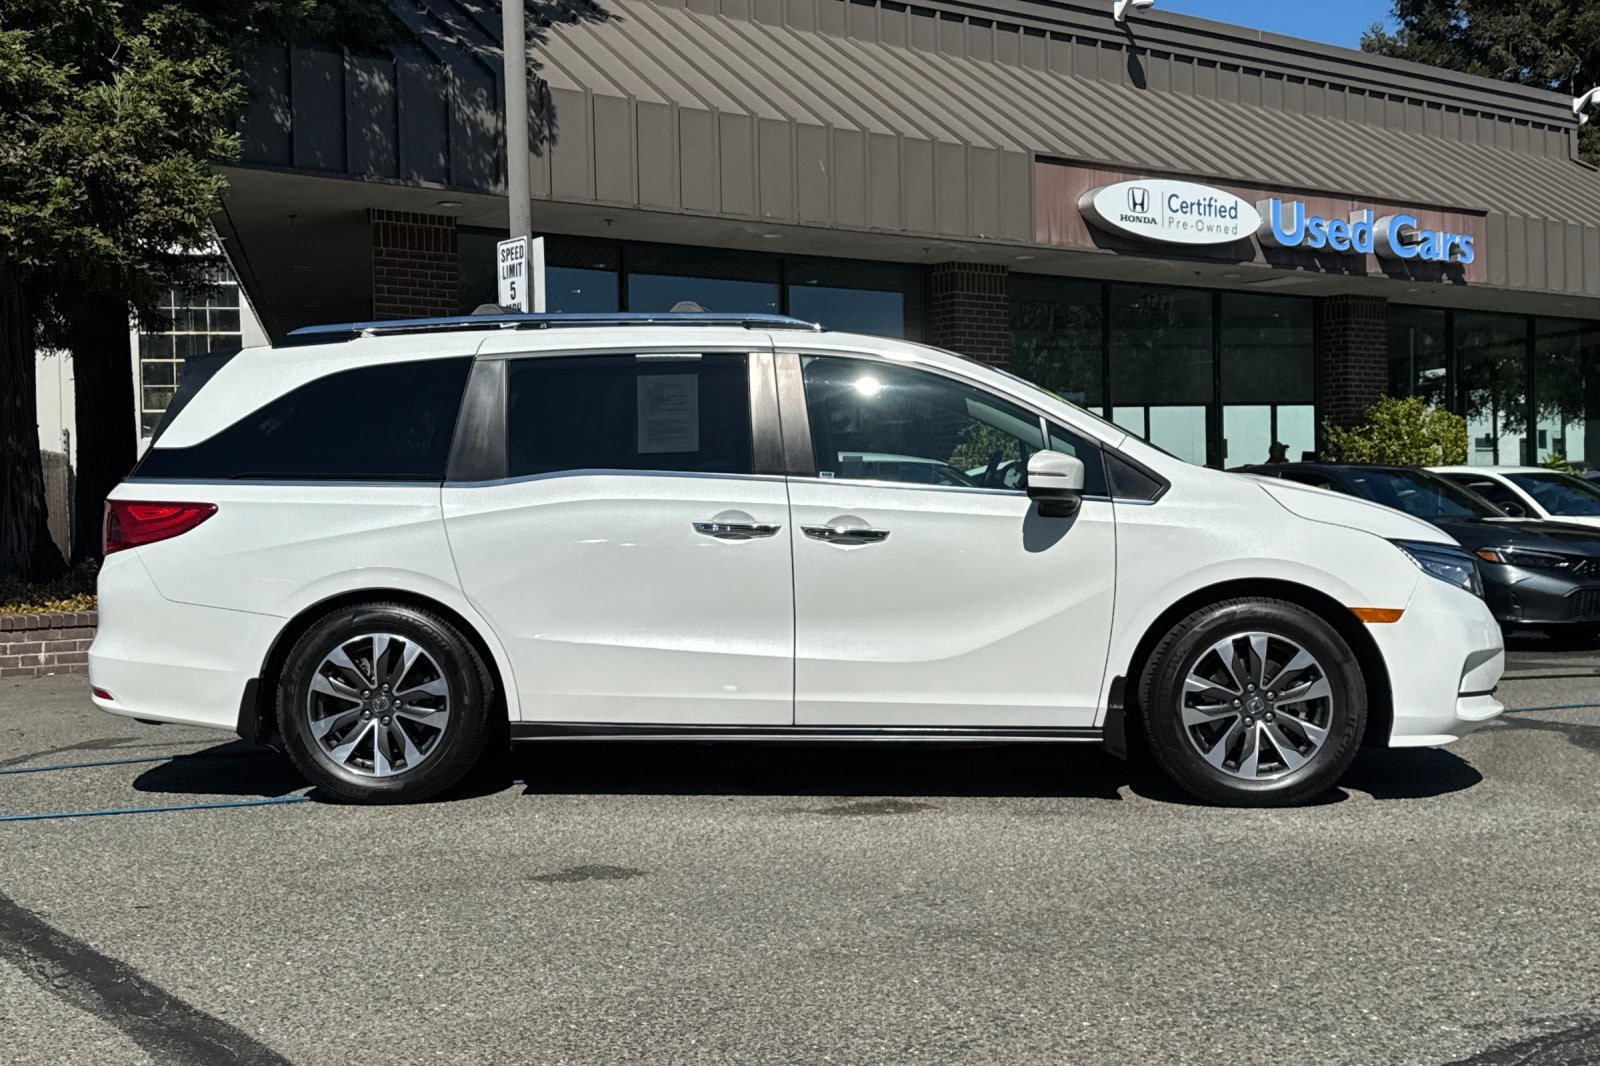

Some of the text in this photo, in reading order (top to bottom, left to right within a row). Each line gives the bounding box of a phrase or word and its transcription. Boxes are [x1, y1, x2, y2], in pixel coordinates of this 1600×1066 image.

[1167, 193, 1238, 220] Certified
[1120, 213, 1158, 225] HONDA
[1168, 216, 1238, 235] Pre-Owned
[1269, 198, 1475, 265] Used Cars
[501, 244, 524, 263] SPEED
[502, 262, 523, 280] LIMIT
[510, 281, 517, 300] 5
